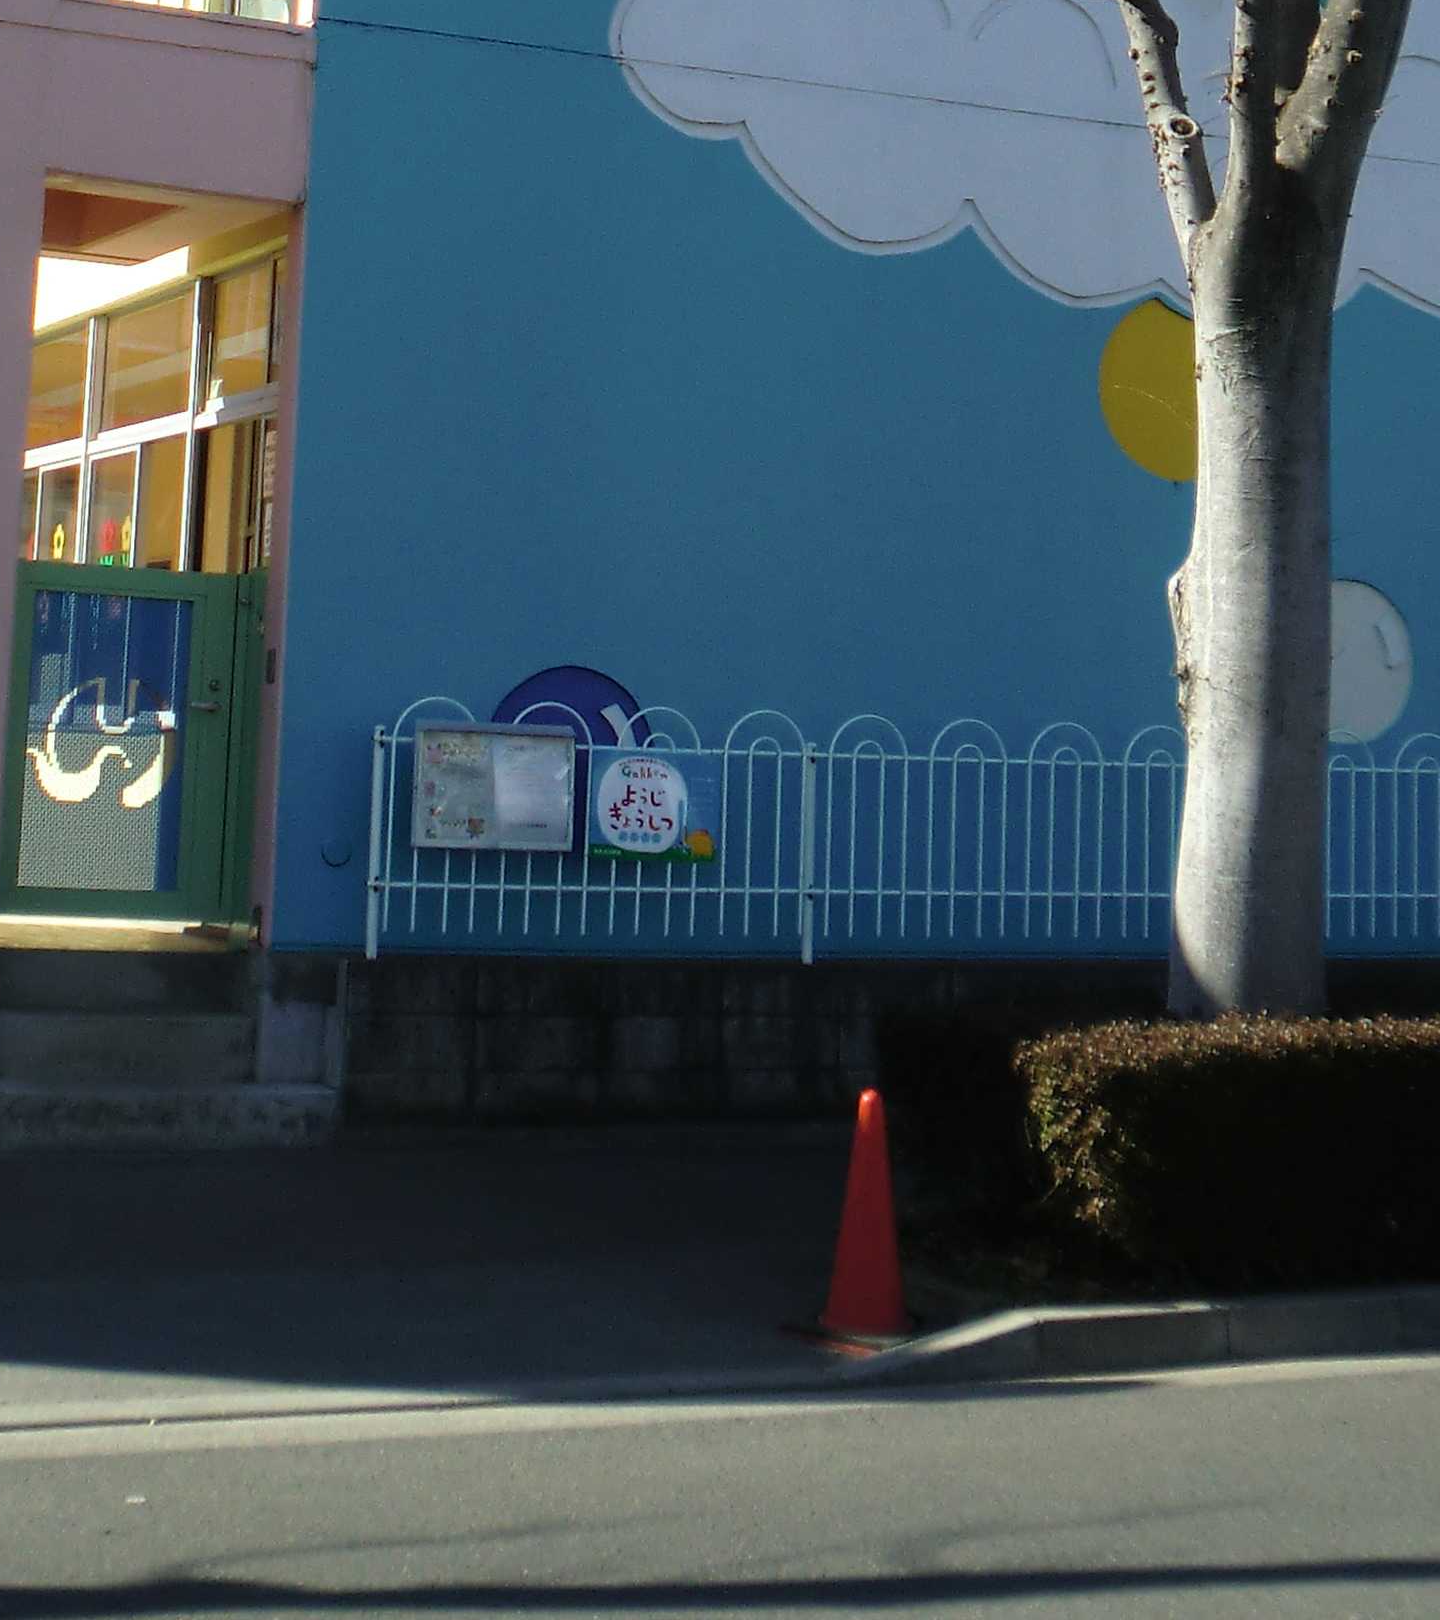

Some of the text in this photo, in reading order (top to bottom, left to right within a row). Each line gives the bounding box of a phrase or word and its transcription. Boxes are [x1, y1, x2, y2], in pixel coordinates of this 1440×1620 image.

[621, 784, 666, 807] ようじ
[608, 802, 674, 832] きょうしつ
